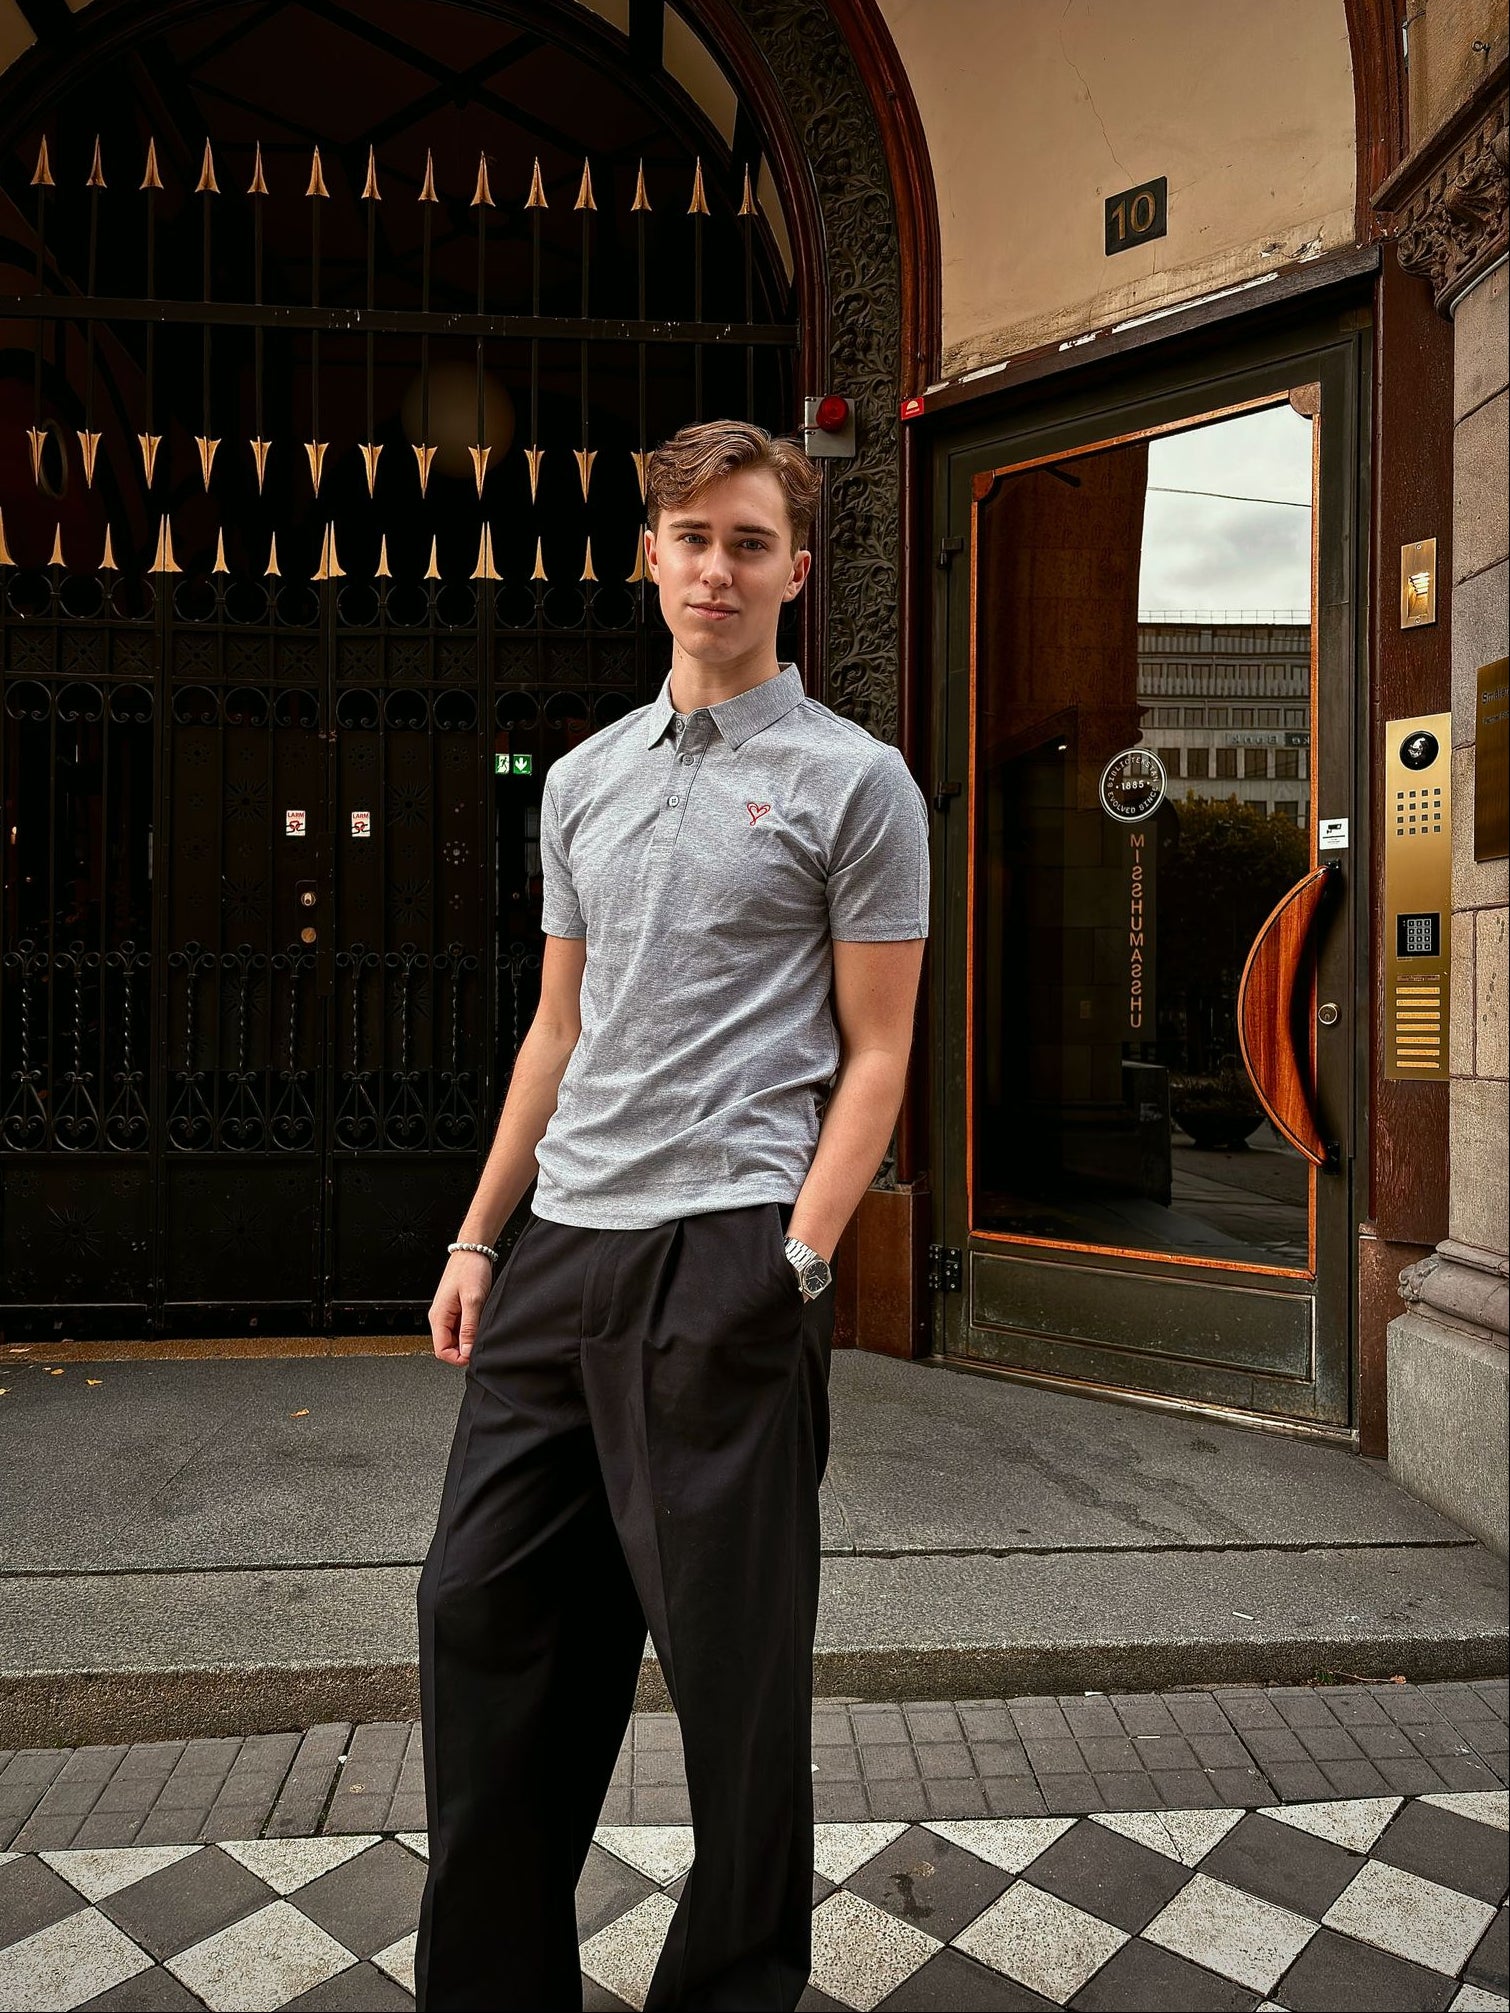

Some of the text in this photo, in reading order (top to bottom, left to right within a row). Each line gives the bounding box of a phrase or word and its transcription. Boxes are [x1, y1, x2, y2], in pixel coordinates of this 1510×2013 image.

[1111, 190, 1156, 240] 10
[1121, 780, 1145, 791] 1885
[1107, 786, 1159, 814] EVOLVED SINCE
